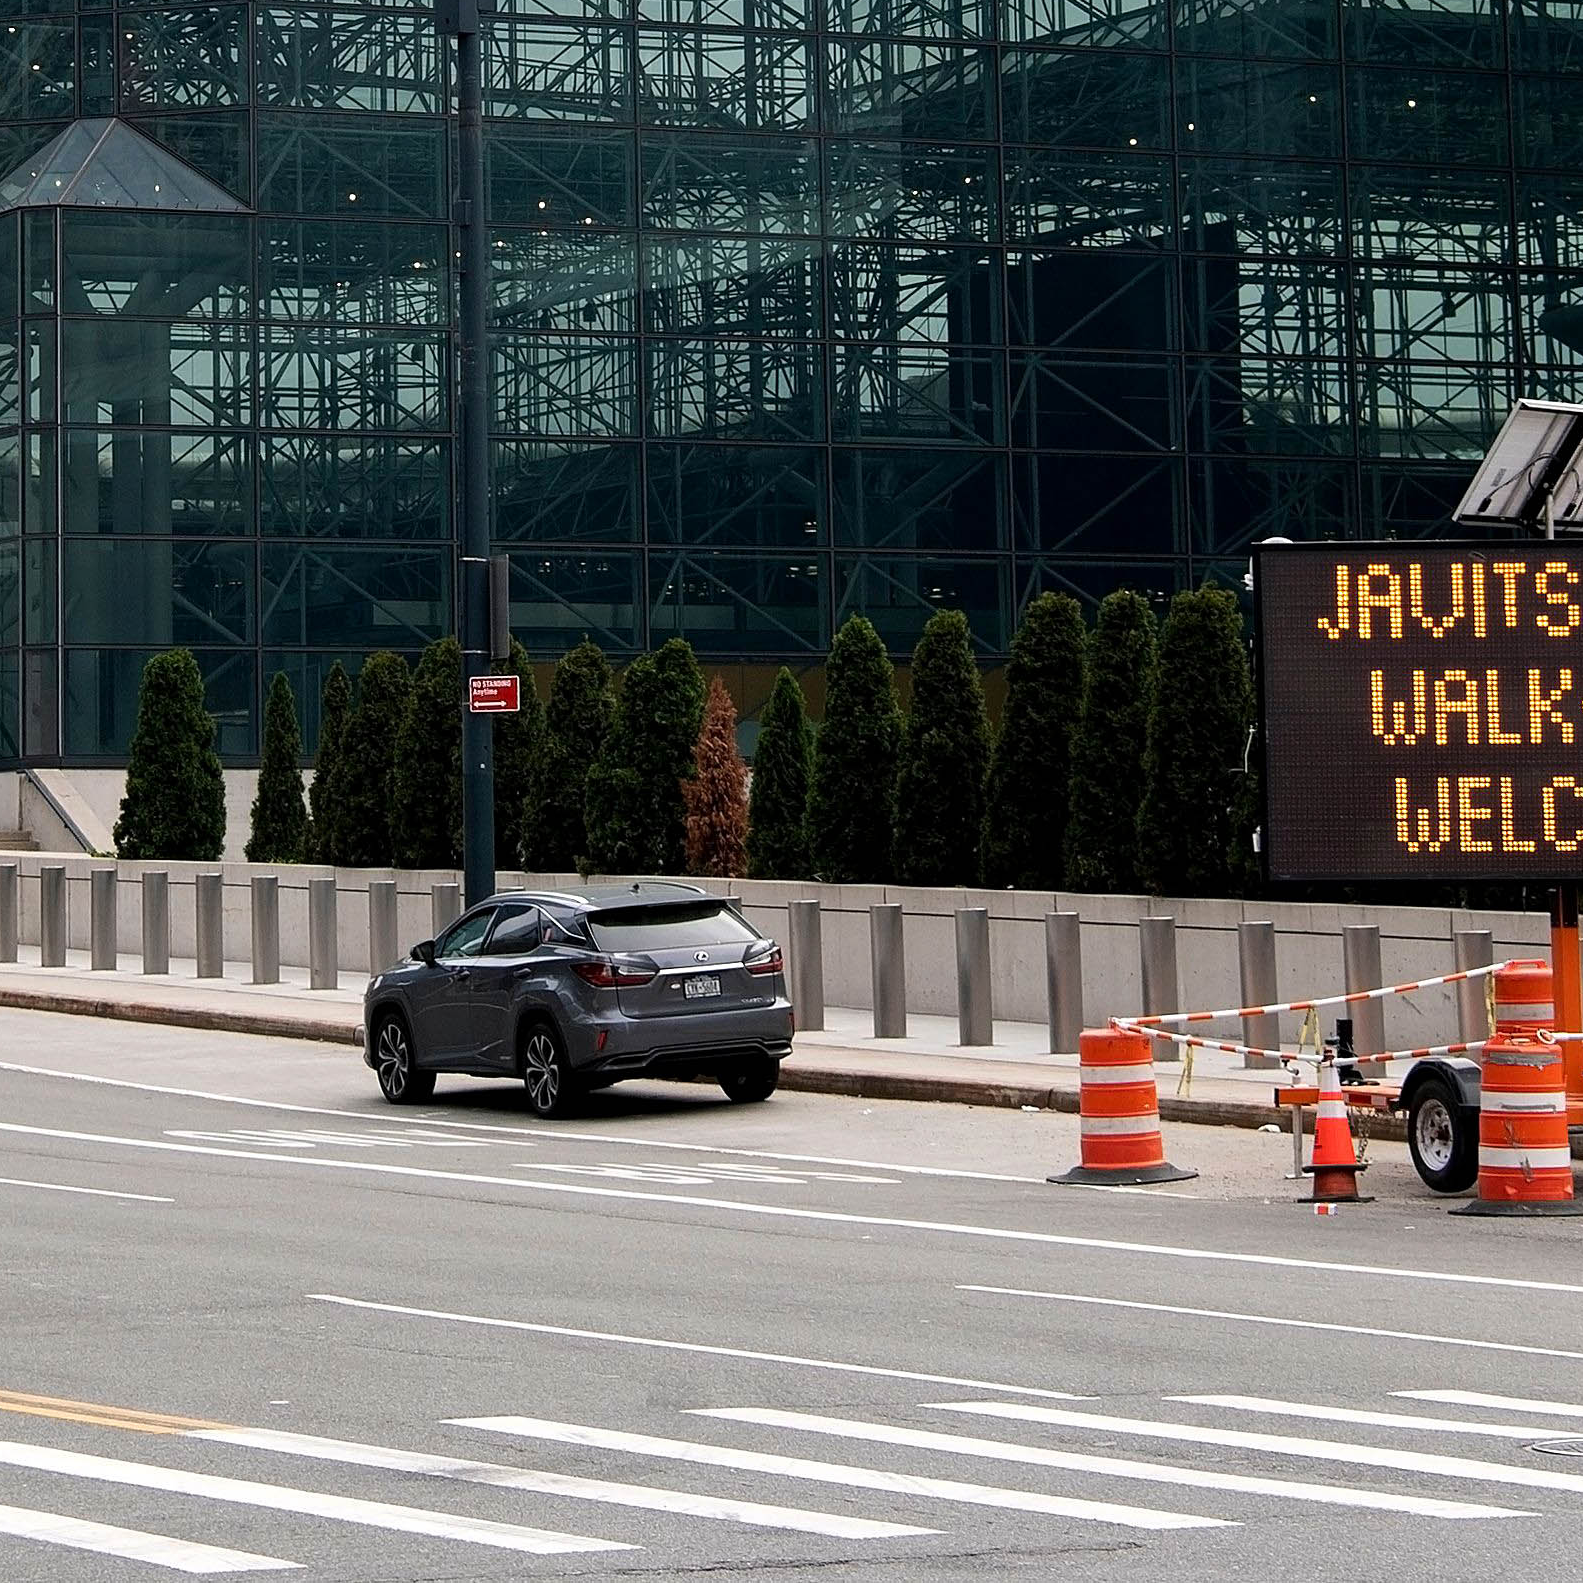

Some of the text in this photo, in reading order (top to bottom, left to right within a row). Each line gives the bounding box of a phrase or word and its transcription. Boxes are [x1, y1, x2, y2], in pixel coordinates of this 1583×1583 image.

[1317, 561, 1581, 640] JAVITS
[472, 679, 511, 688] NO STANDING
[473, 688, 498, 696] Anytime
[161, 1129, 539, 1148] ONLY
[510, 1162, 904, 1185] BUS
